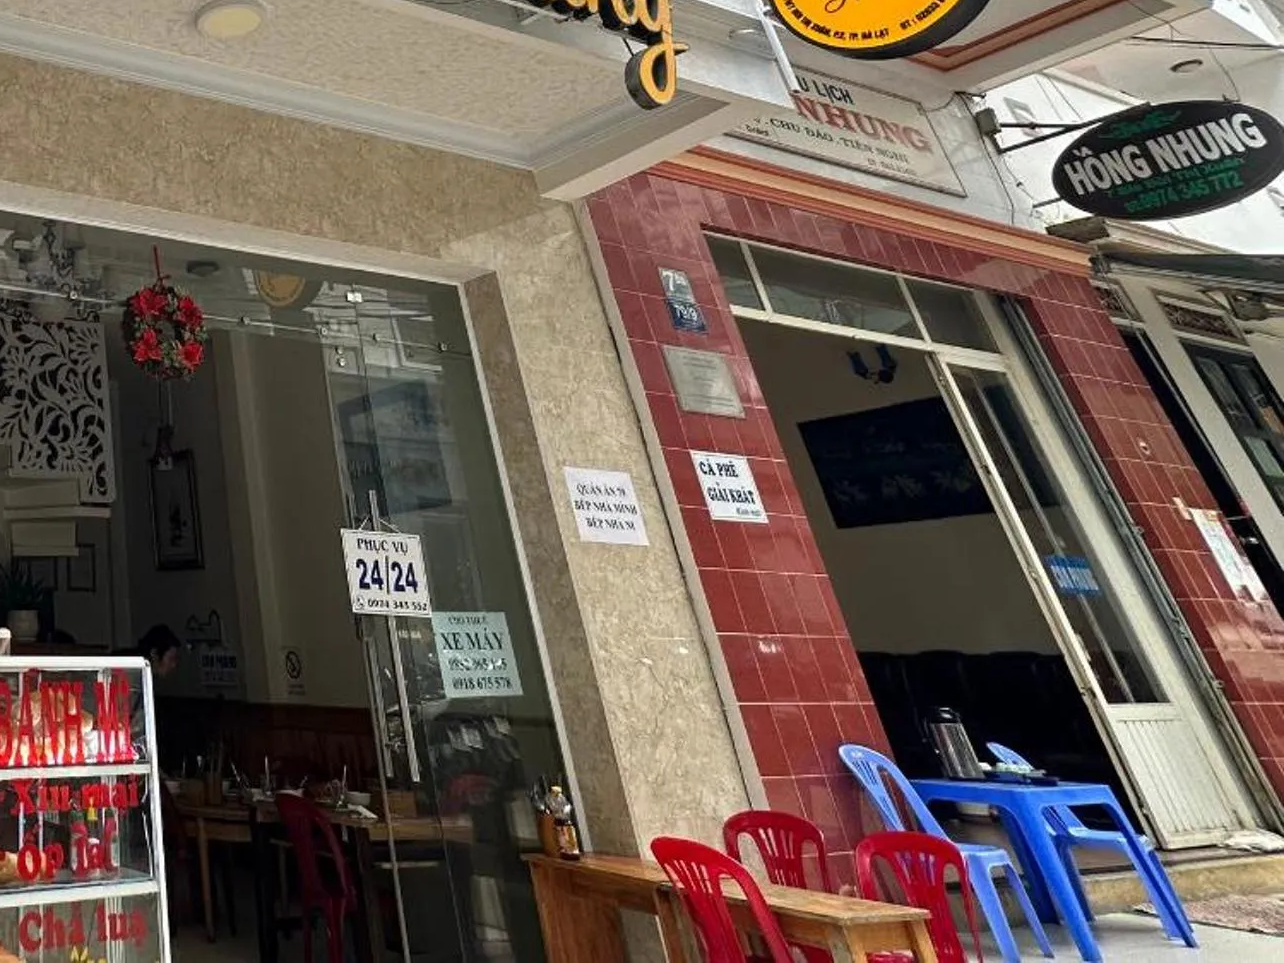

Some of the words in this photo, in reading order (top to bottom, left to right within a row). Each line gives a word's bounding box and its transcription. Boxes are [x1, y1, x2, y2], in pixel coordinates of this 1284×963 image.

[796, 75, 810, 92] U
[790, 93, 934, 154] NHUNG
[1064, 144, 1153, 196] HỒNG
[1144, 113, 1268, 173] NHUNG
[716, 460, 739, 478] PHÊ
[357, 538, 390, 553] PHỤC
[393, 540, 409, 556] VỤ
[440, 632, 464, 650] XE
[465, 627, 504, 650] MÁY
